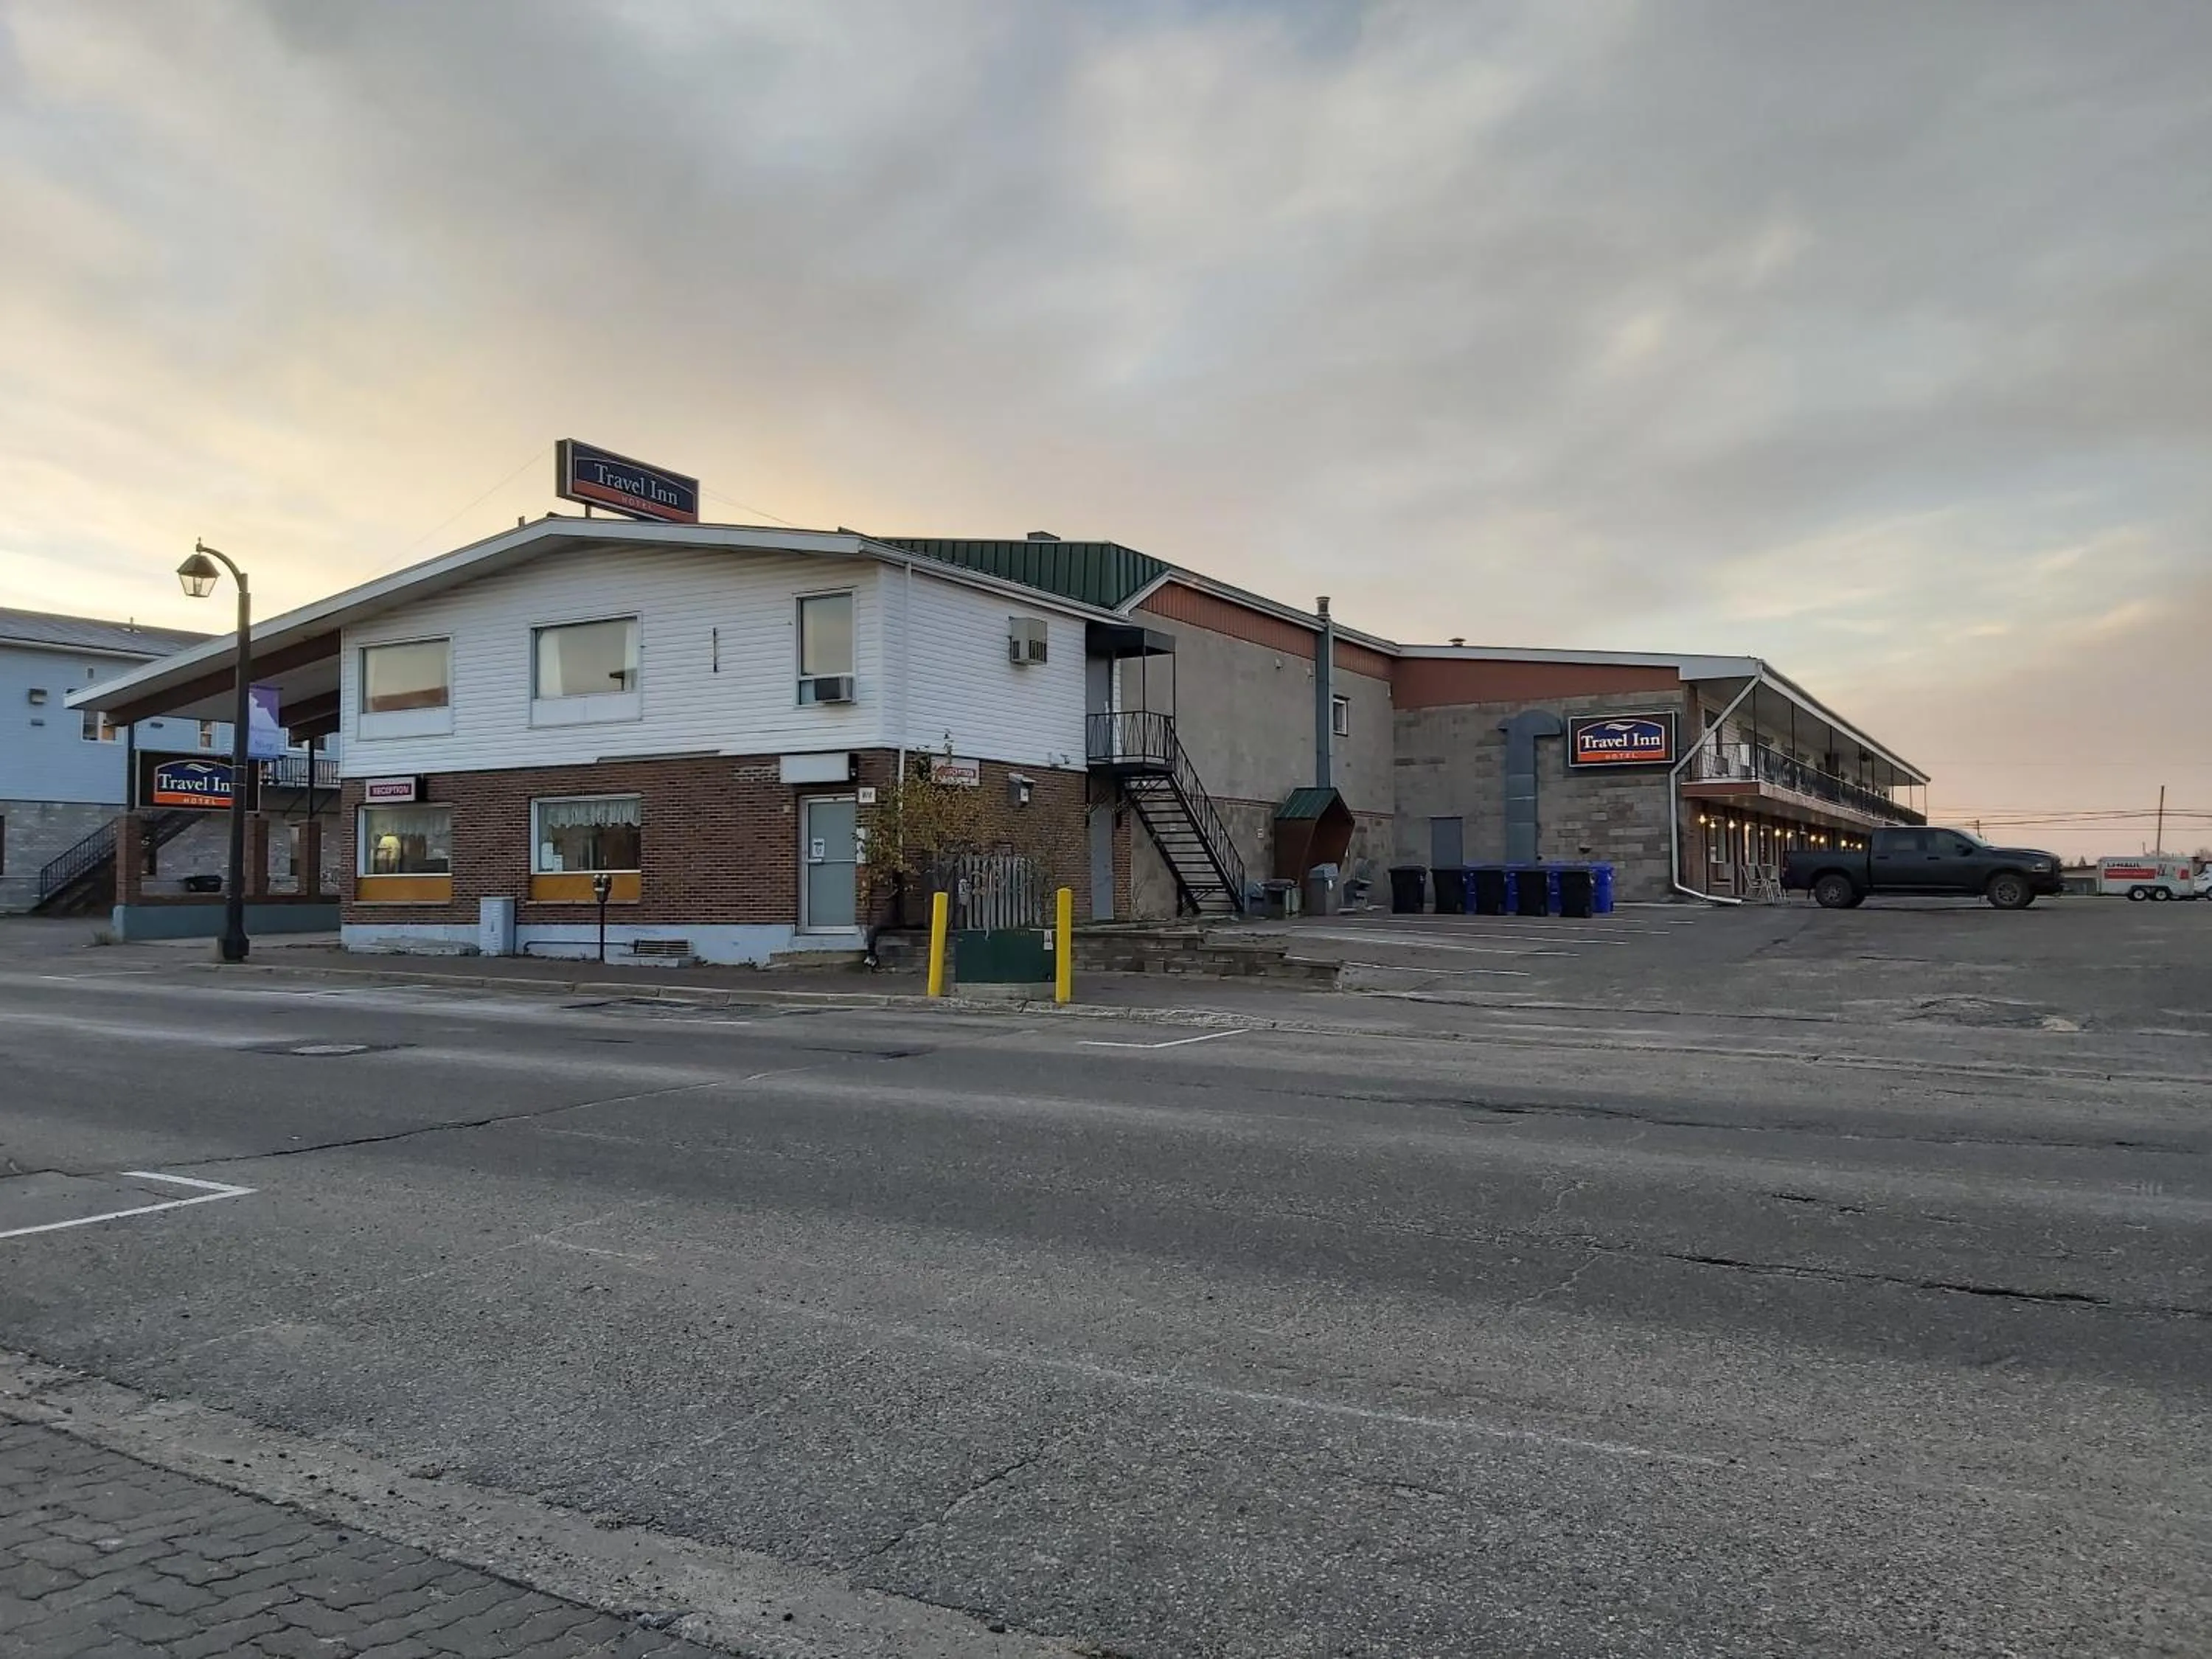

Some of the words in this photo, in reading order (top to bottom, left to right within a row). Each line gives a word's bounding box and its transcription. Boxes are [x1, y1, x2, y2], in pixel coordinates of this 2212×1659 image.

[594, 463, 644, 495] Travel
[650, 480, 678, 505] Inn
[622, 495, 654, 510] HOTEL
[1581, 734, 1627, 748] Travel
[1632, 733, 1661, 746] Inn
[159, 773, 208, 791] Travel
[213, 776, 231, 793] In
[371, 785, 410, 796] RECEPTION
[183, 797, 216, 805] HOTEL
